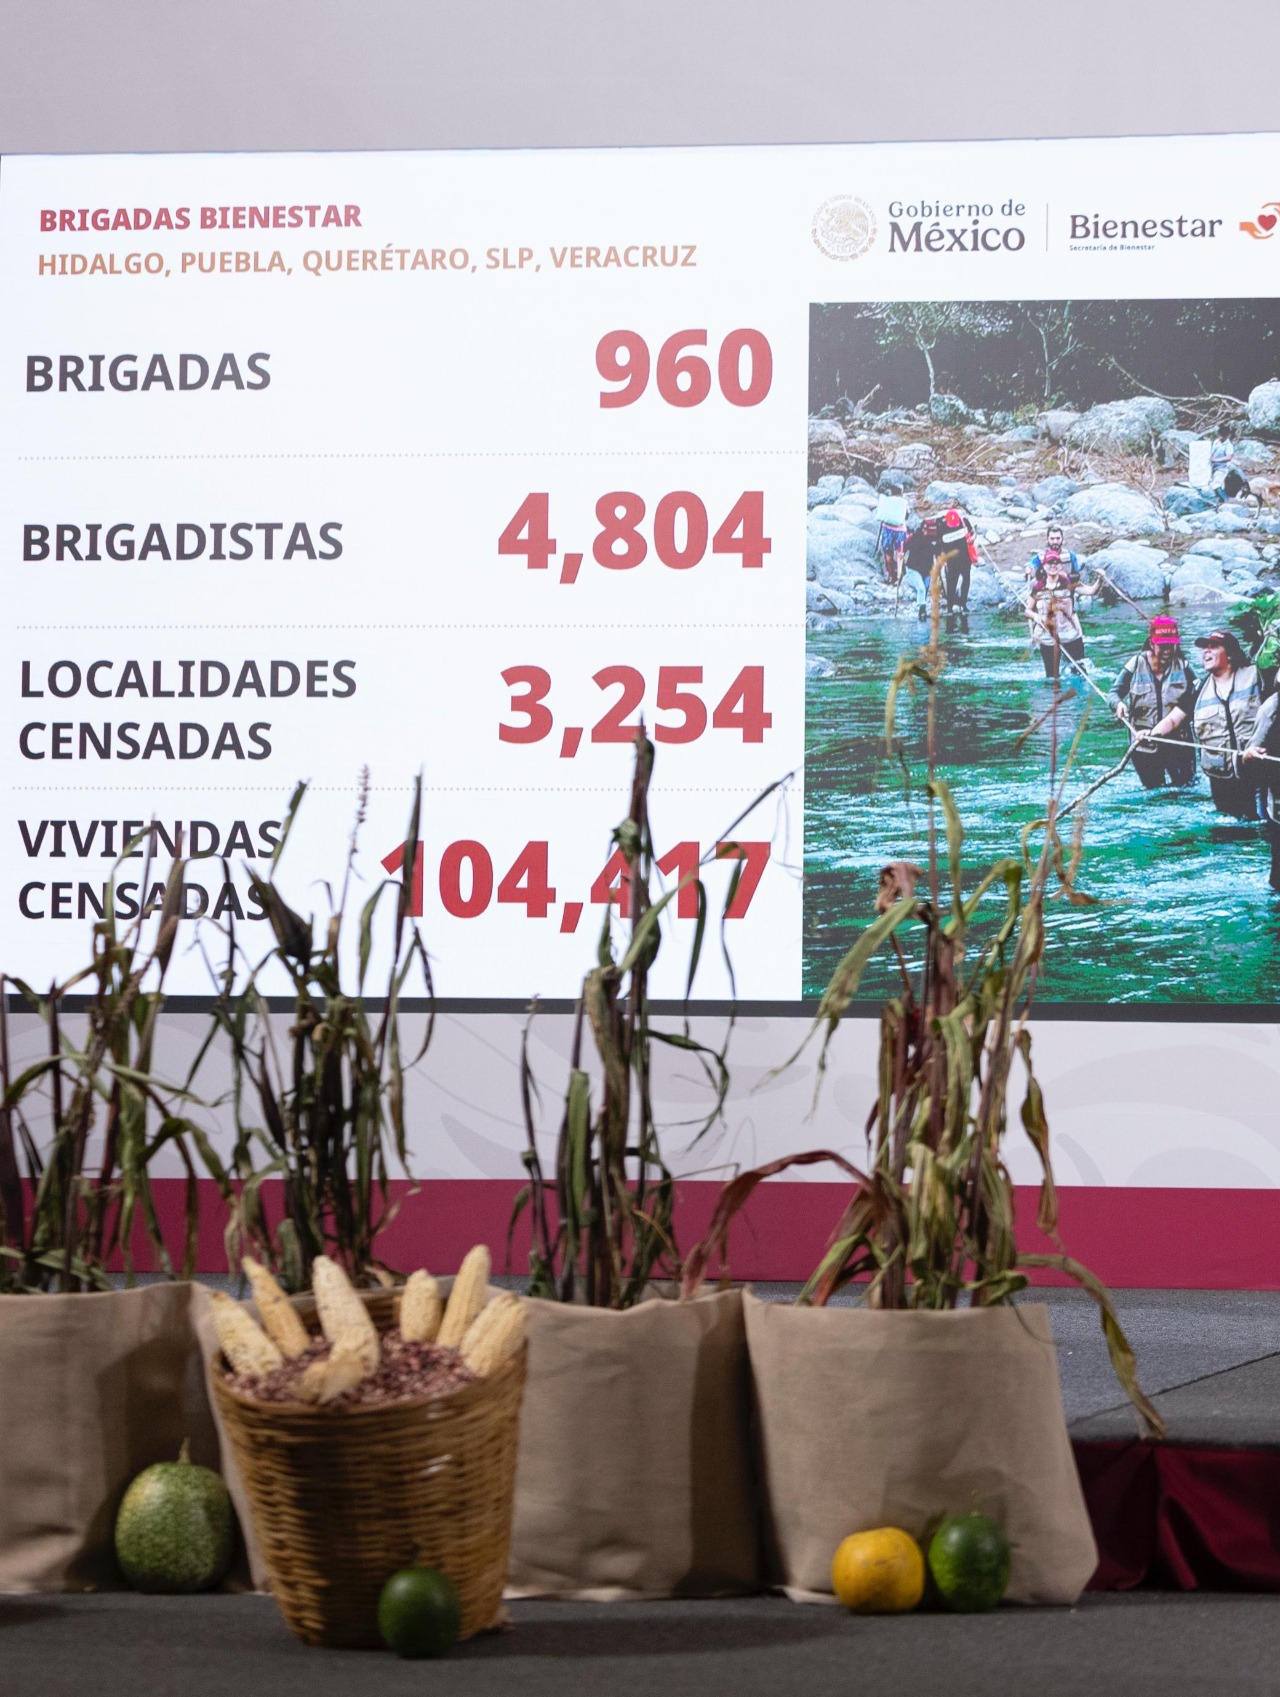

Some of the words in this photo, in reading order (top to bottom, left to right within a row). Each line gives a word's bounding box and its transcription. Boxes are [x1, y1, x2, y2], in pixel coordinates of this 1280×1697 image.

[40, 208, 191, 232] BRIGADAS
[200, 205, 363, 230] BIENESTAR
[888, 200, 994, 218] Gobierno
[1000, 198, 1026, 217] de
[1070, 213, 1223, 239] Bienestar
[888, 218, 1026, 253] México
[38, 252, 171, 278] HIDALGO,
[181, 251, 293, 276] PUEBLA,
[302, 243, 477, 276] QUERÉTARO,
[485, 247, 541, 273] SLP,
[549, 245, 697, 269] VERACRUZ
[26, 352, 271, 393] BRIGADAS
[595, 327, 773, 409] 960
[22, 521, 343, 562] BRIGADISTAS
[497, 490, 772, 585] 4,804
[21, 659, 357, 699] LOCALIDADES
[498, 664, 773, 759] 3,254
[18, 721, 272, 761] CENSADAS
[17, 820, 282, 858] VIVIENDAS
[380, 839, 772, 933] 104,417
